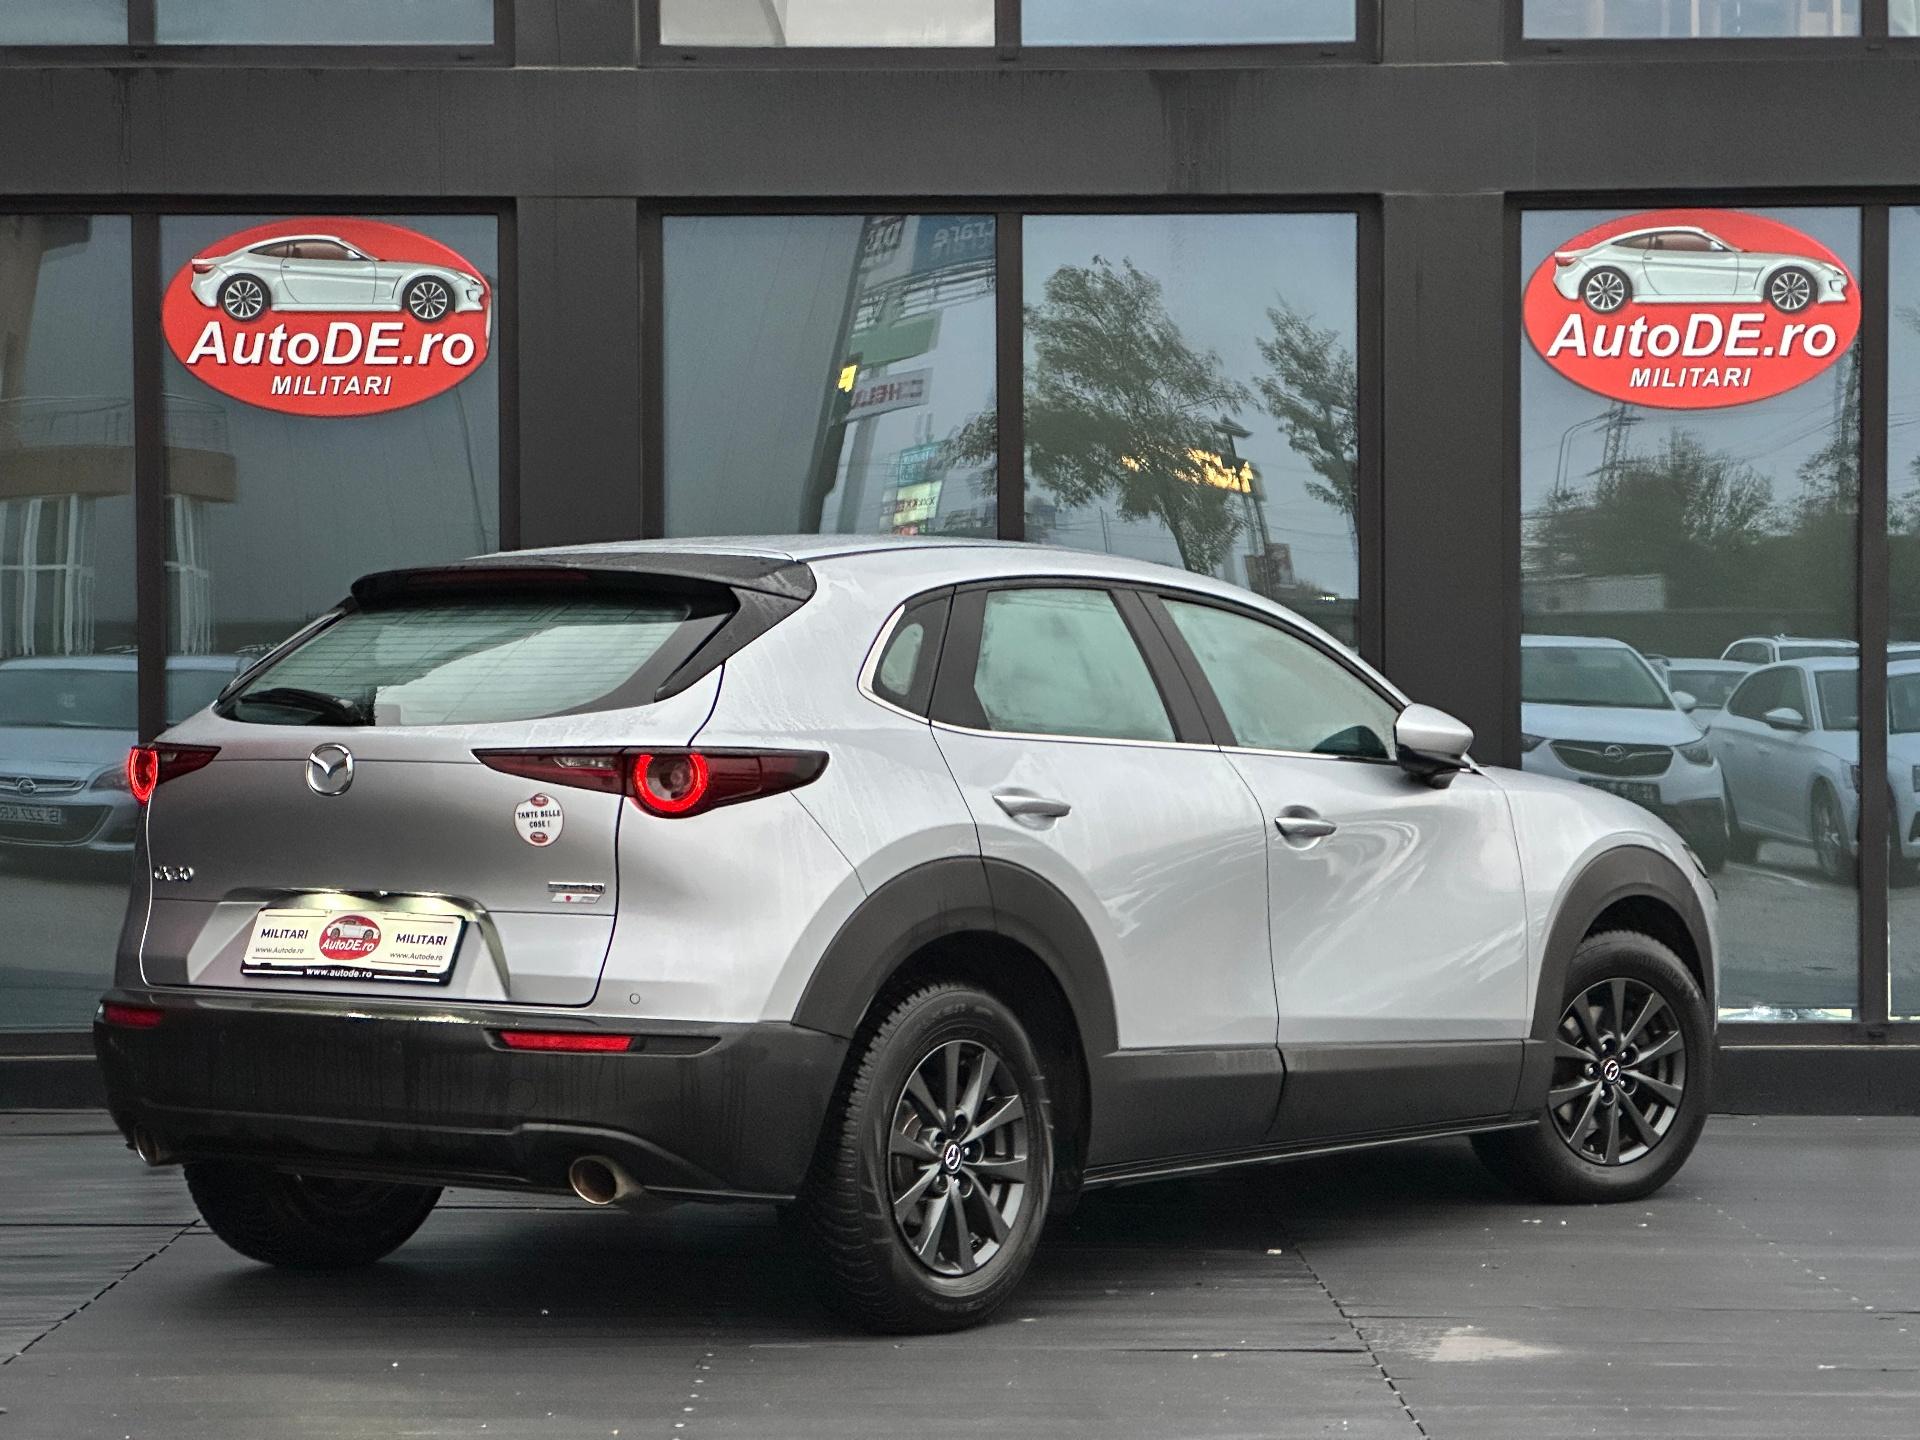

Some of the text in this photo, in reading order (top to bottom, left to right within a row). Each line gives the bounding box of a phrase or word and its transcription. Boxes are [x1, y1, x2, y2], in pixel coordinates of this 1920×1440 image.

[1547, 313, 1837, 358] AutoDE.ro
[186, 321, 475, 366] AutoDE.ro
[1628, 367, 1752, 388] MILITARI
[270, 376, 392, 396] MILITARI
[517, 809, 561, 820] TANTE BELLE
[529, 820, 546, 829] COSE
[260, 928, 309, 940] MILITARI
[395, 932, 448, 947] MILITARI
[255, 946, 304, 955] www.Autode.ro
[321, 938, 375, 952] AutoDE.ro
[390, 952, 443, 962] www.Autode.ro
[306, 967, 372, 979] www.autode.ro
